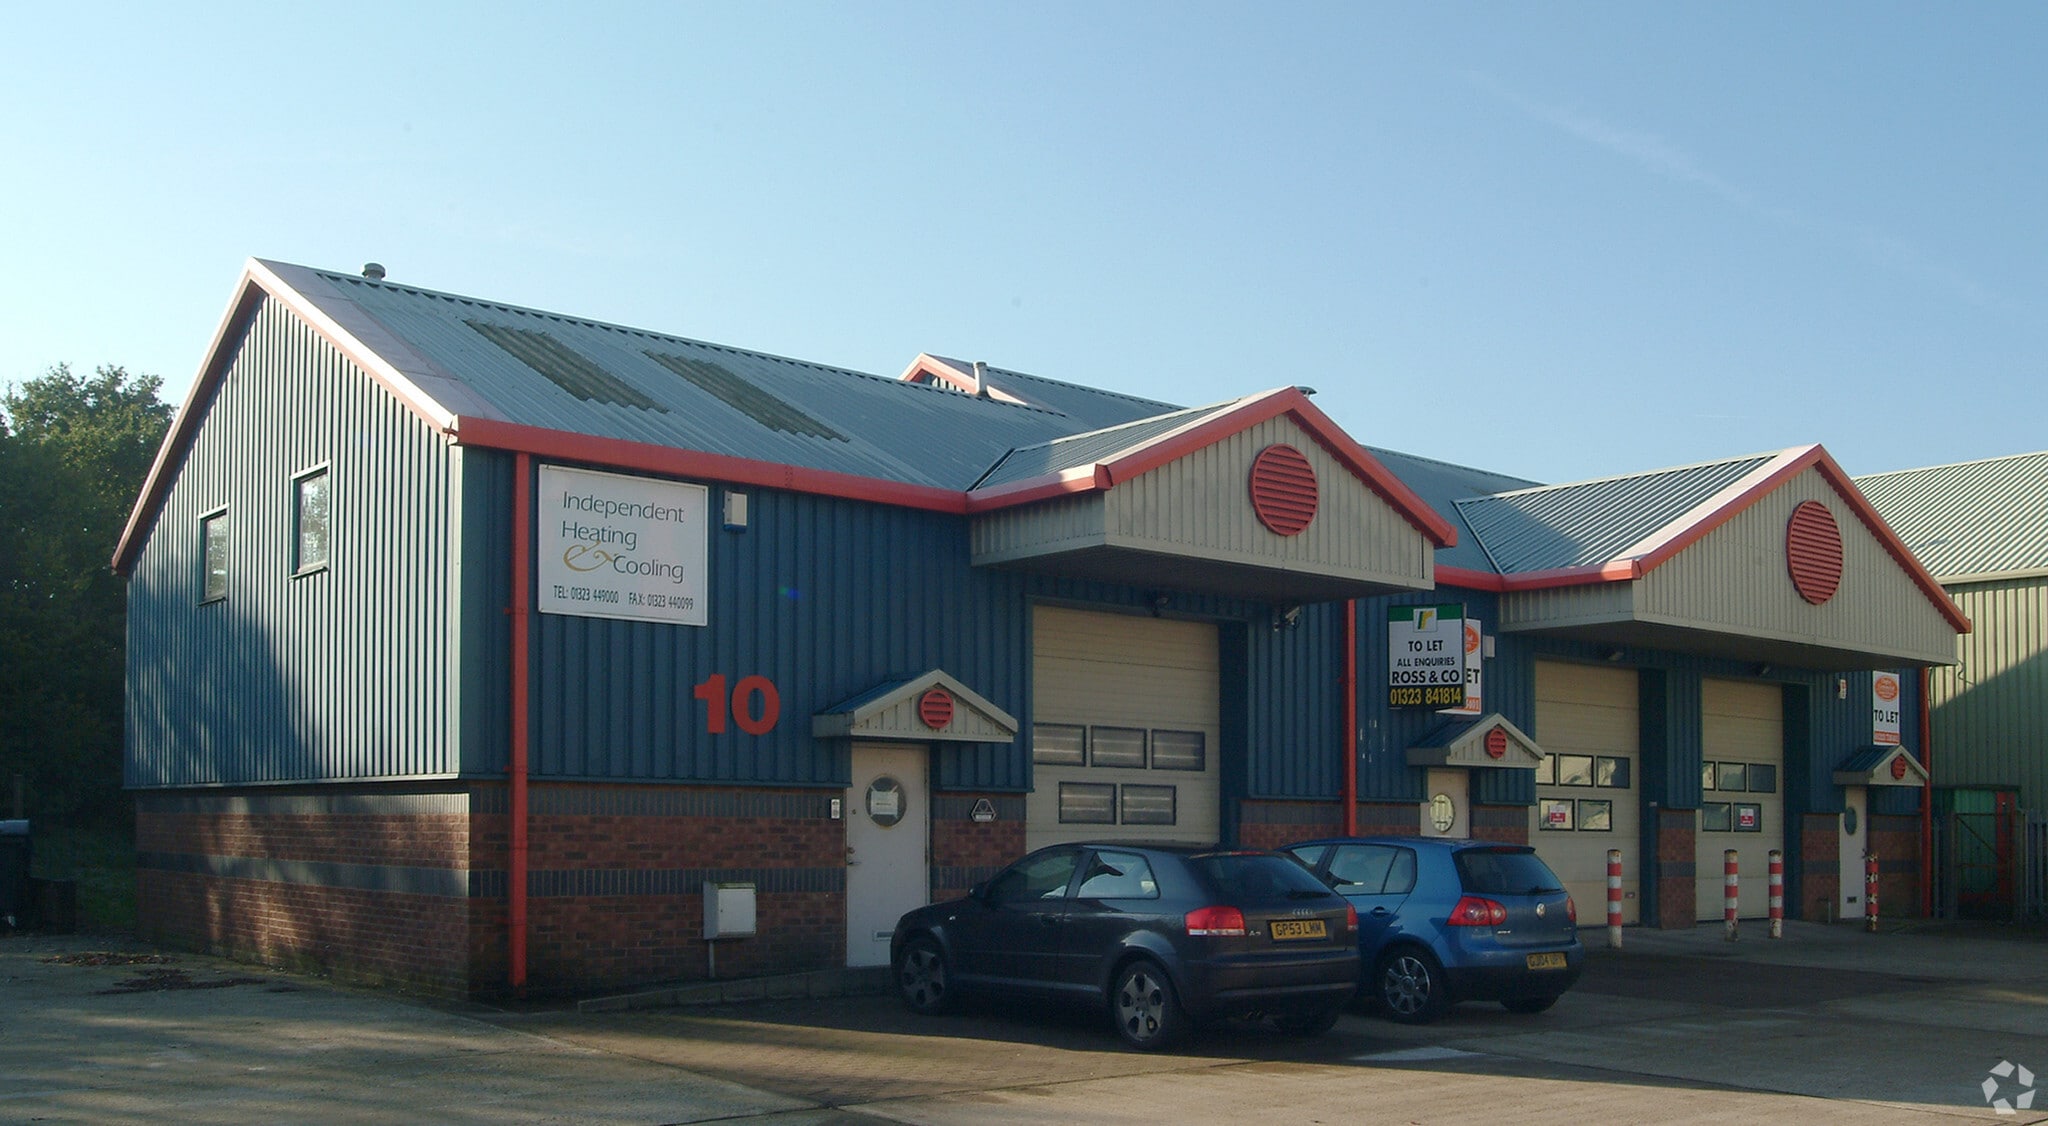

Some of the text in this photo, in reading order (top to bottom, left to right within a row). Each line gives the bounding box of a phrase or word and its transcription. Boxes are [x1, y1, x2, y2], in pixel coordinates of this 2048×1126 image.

[563, 491, 685, 523] Independent
[562, 520, 638, 551] Heating
[613, 554, 684, 584] Cooling
[553, 585, 568, 599] TEL:
[570, 587, 590, 601] 01323
[593, 589, 619, 604] 449000
[628, 592, 646, 606] FAX:
[647, 594, 666, 608] 01323
[1408, 640, 1443, 652] TO LET
[1397, 657, 1455, 667] ALL ENQUIRIES
[1392, 669, 1460, 684] ROSS & CO
[1466, 668, 1480, 684] ET
[694, 673, 780, 735] 10
[1390, 688, 1422, 705] 01323
[1425, 687, 1461, 705] 841814
[1874, 709, 1899, 723] TO LET
[1276, 922, 1301, 935] GP53
